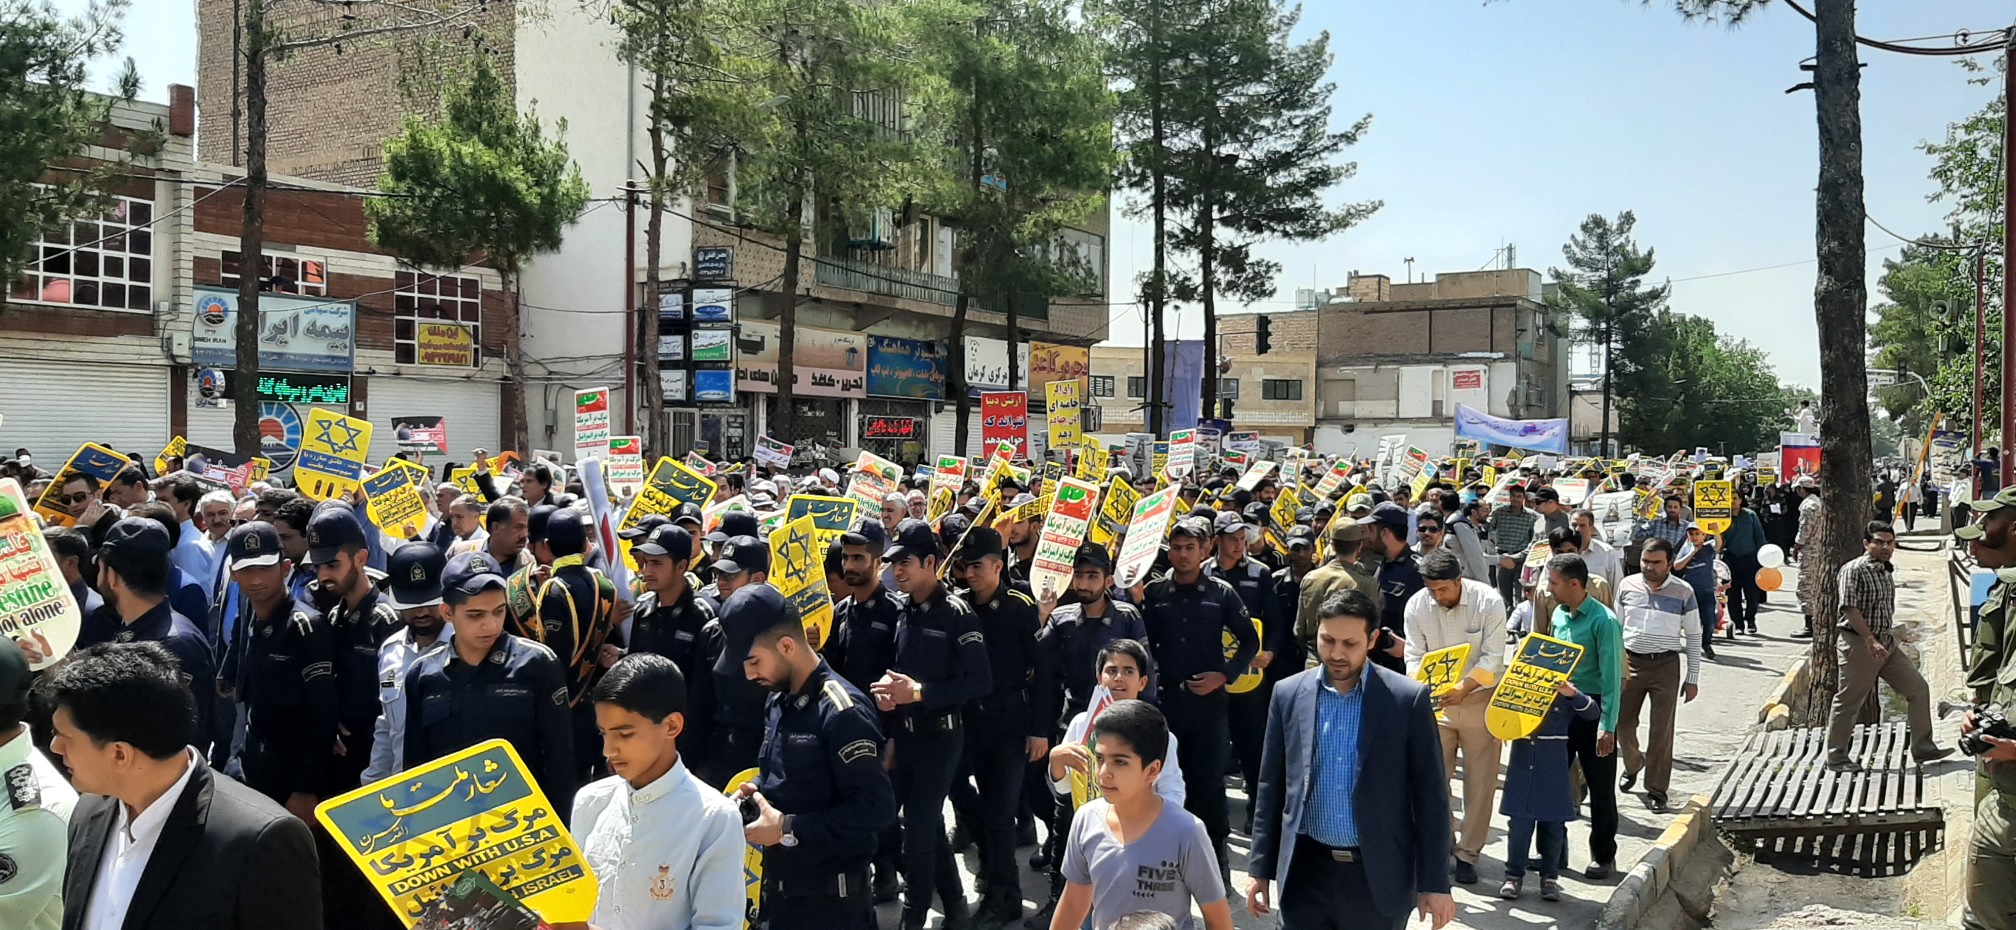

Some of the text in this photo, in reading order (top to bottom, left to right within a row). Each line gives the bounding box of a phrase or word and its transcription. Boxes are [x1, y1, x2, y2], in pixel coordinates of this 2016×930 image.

[304, 306, 348, 317] شرکت سهامی
[304, 319, 349, 350] بیمه
[750, 369, 863, 391] تحریر کاغذ های
[968, 363, 986, 383] کرمان
[988, 366, 1007, 384] مرکزی
[1053, 384, 1073, 396] وای اگر
[985, 396, 1021, 408] ارتش دنیا
[1049, 397, 1078, 412] خامنه ای
[985, 415, 1024, 430] نتواند که
[984, 436, 1000, 444] دهد
[1058, 430, 1072, 438] دهد
[808, 503, 839, 517] ملت
[828, 505, 849, 522] شعار
[1047, 515, 1085, 538] مرگ بر آمریکا
[1038, 543, 1060, 558] اسرائیل
[1056, 550, 1064, 560] بر
[6, 556, 42, 582] تنها
[0, 580, 55, 612] estine
[20, 601, 65, 627] alone
[1553, 651, 1574, 665] شعار
[1511, 664, 1564, 687] مرگ بر آمریکا
[1506, 678, 1554, 695] DOWN WITH U.S.A
[1498, 686, 1550, 707] مرگ بر اسرائیل
[379, 759, 508, 816] شعار ملت ما
[490, 807, 548, 834] مرگ
[467, 825, 487, 851] بر
[369, 828, 453, 877] آمریکا
[395, 829, 554, 894] DOWN WITH U.S.A
[499, 846, 573, 885] مرگ بر
[1138, 864, 1177, 880] FIVE
[522, 868, 579, 897] ISRAEL
[1137, 880, 1176, 892] THREE
